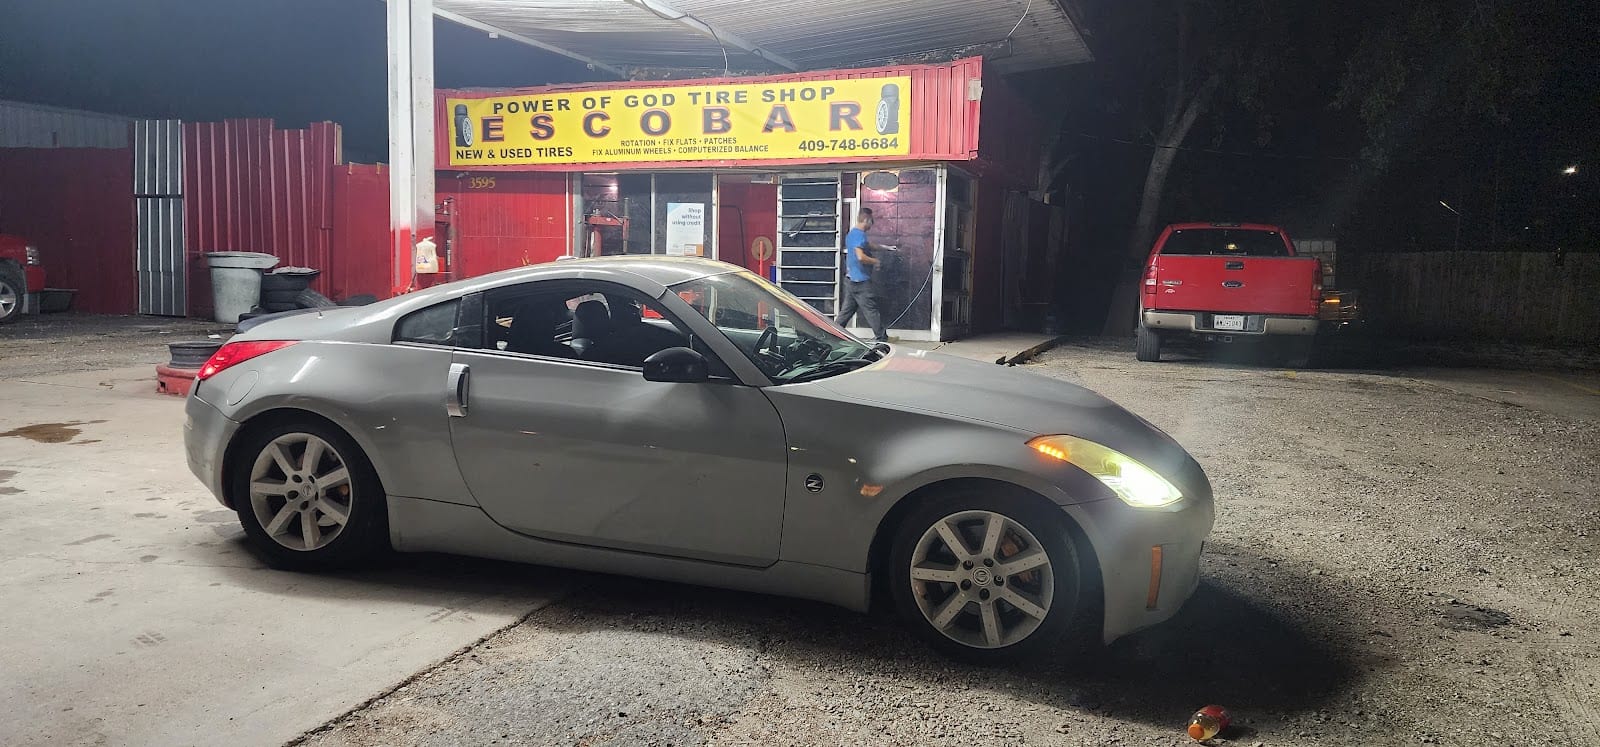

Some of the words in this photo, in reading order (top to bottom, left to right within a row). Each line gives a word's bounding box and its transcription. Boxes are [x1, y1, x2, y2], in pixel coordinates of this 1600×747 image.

[493, 98, 570, 114] POWER
[582, 96, 611, 110] OF
[624, 93, 675, 108] GOD
[688, 90, 748, 105] TIRE
[761, 86, 835, 103] SHOP
[481, 100, 864, 143] ESCOBAR
[621, 139, 656, 147] ROTATION
[663, 138, 674, 146] FIX
[798, 137, 899, 152] 409-748-6684
[456, 149, 483, 159] NEW
[487, 149, 495, 158] &
[500, 148, 532, 158] USED
[536, 147, 573, 157] TIRES
[605, 148, 641, 156] ALUMINUM
[678, 146, 733, 154] COMPUTERIZED
[469, 176, 496, 189] 3595
